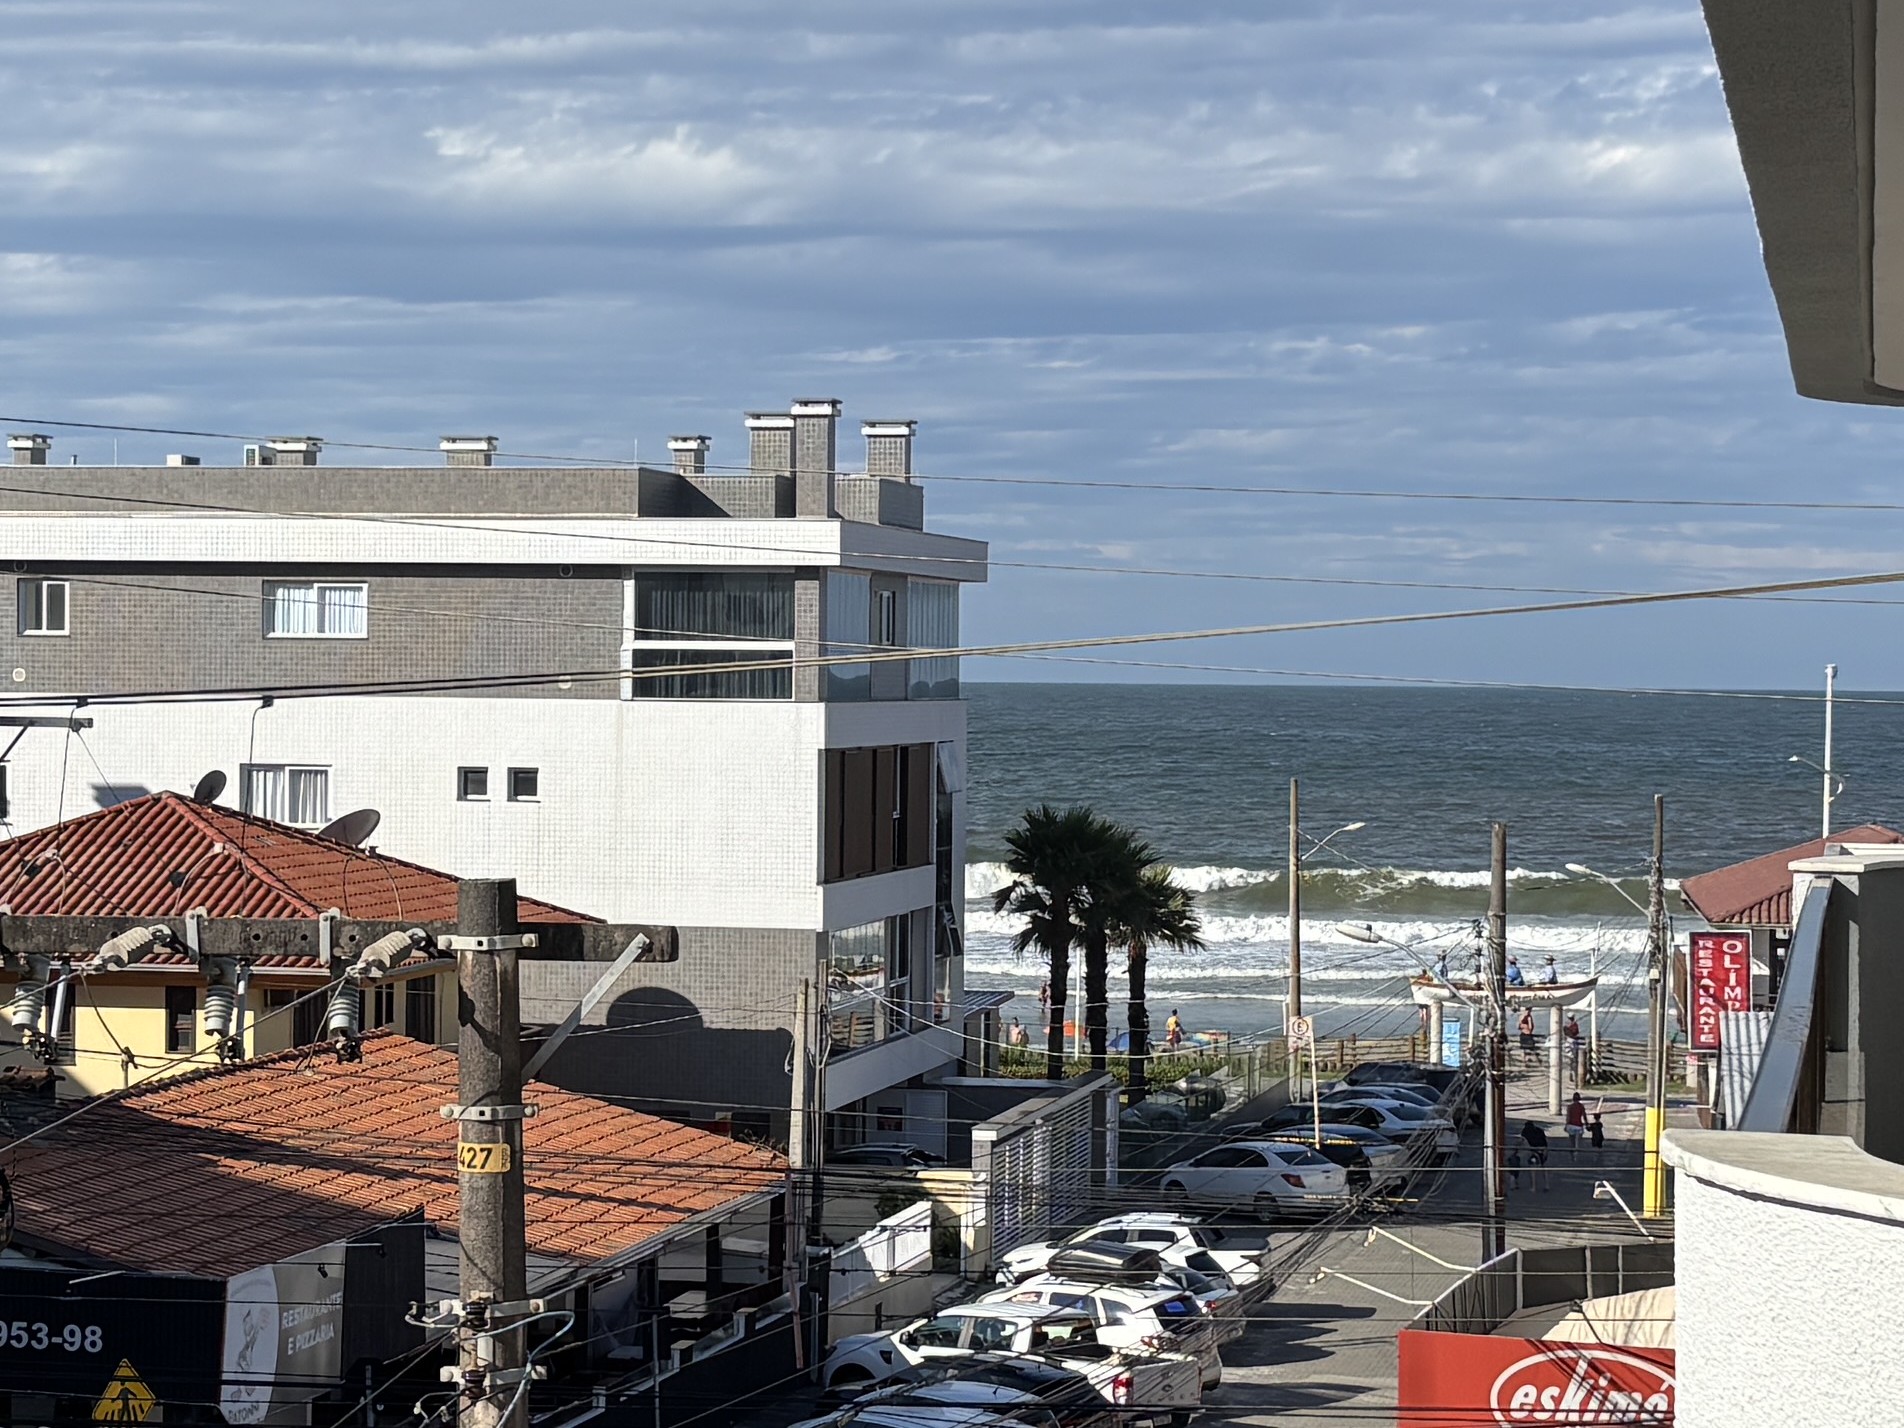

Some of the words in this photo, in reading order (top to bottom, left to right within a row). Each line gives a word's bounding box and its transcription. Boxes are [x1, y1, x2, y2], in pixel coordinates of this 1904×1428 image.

[1698, 940, 1715, 1043] RESTAURANTE
[1722, 940, 1743, 1012] OLÍMP
[281, 1291, 342, 1328] RESTAURANTE
[287, 1337, 295, 1355] E
[295, 1322, 335, 1352] PIZZARIA
[1510, 1357, 1669, 1425] eskimó
